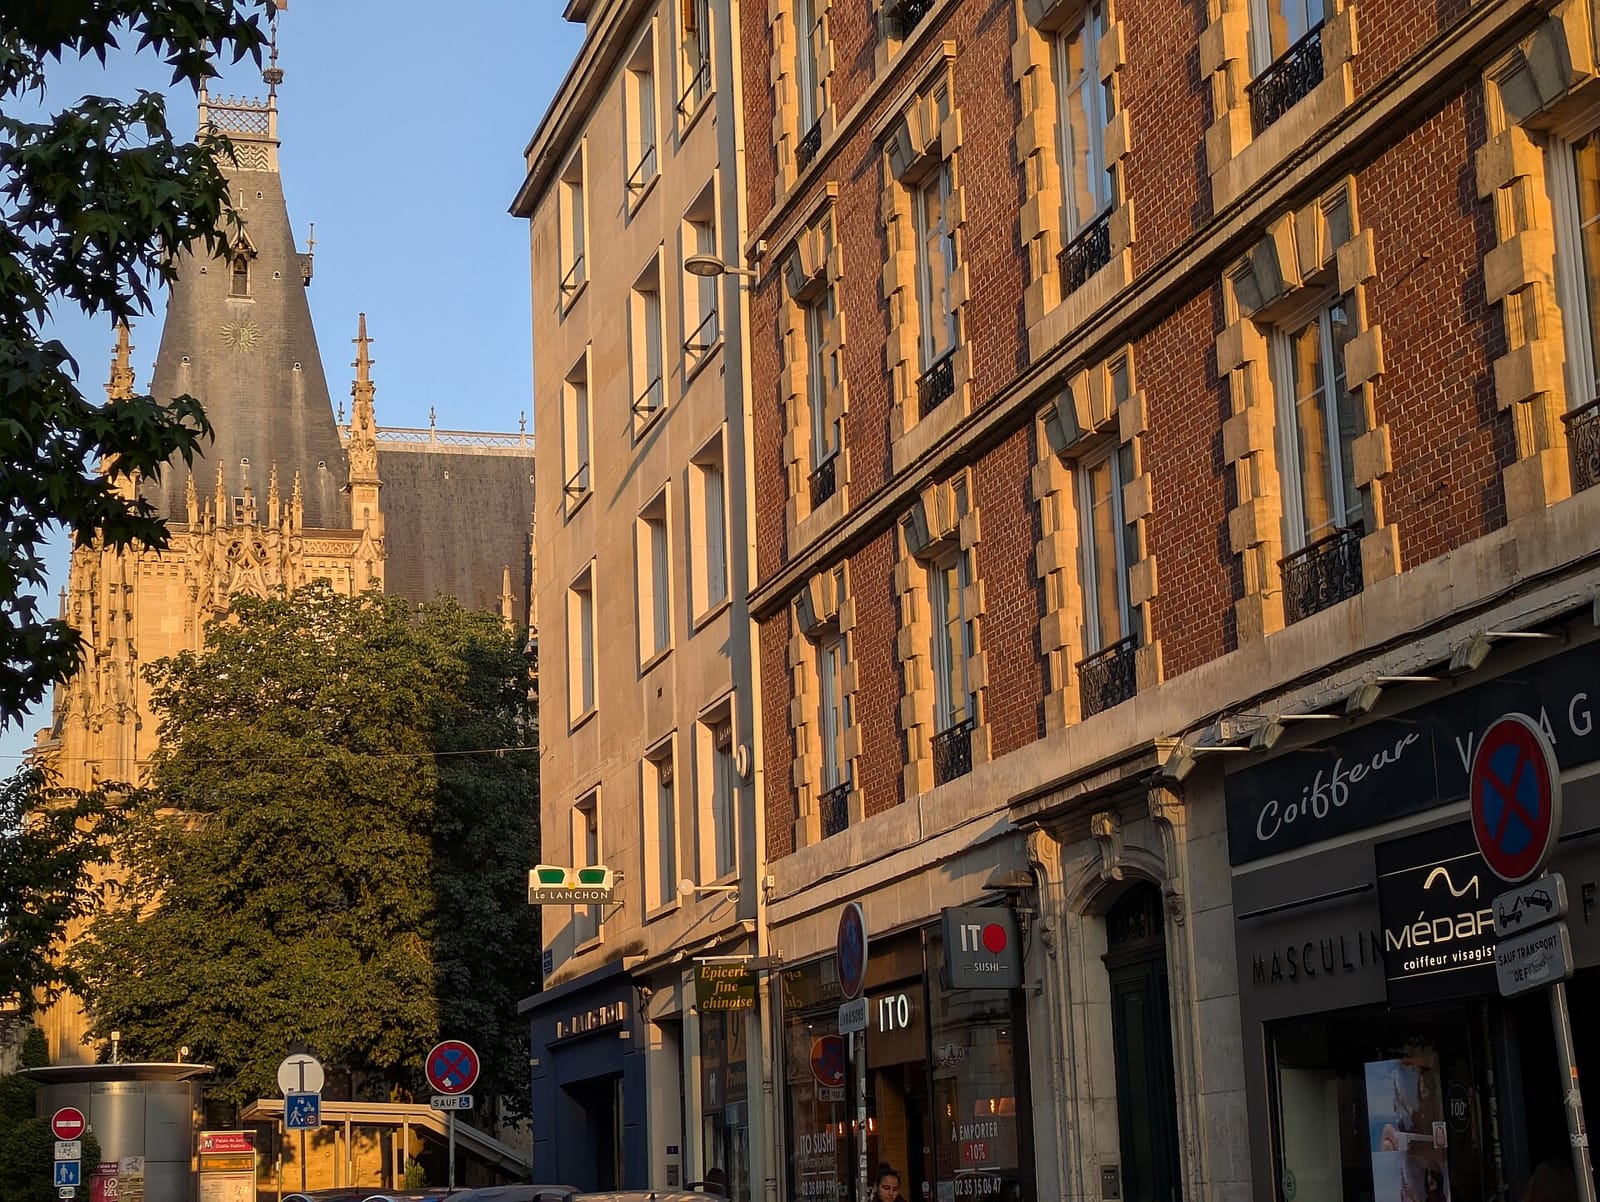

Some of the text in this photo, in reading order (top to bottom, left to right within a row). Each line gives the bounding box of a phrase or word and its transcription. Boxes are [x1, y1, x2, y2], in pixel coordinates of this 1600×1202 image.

[1455, 692, 1593, 774] VAG
[1255, 731, 1421, 841] Coiffeur
[535, 890, 609, 900] Le LANCHON
[1252, 930, 1384, 985] MASCULIN
[1403, 944, 1496, 971] coiffeur visagis
[1498, 935, 1558, 967] SAUF TRANSPORT
[973, 962, 999, 972] SUSHI
[713, 980, 738, 996] fine
[702, 996, 753, 1010] chinoise
[878, 993, 910, 1033] ITO
[433, 1099, 457, 1107] SAUF
[813, 1131, 835, 1154] SUSHI
[951, 1121, 999, 1143] À EMPORTER
